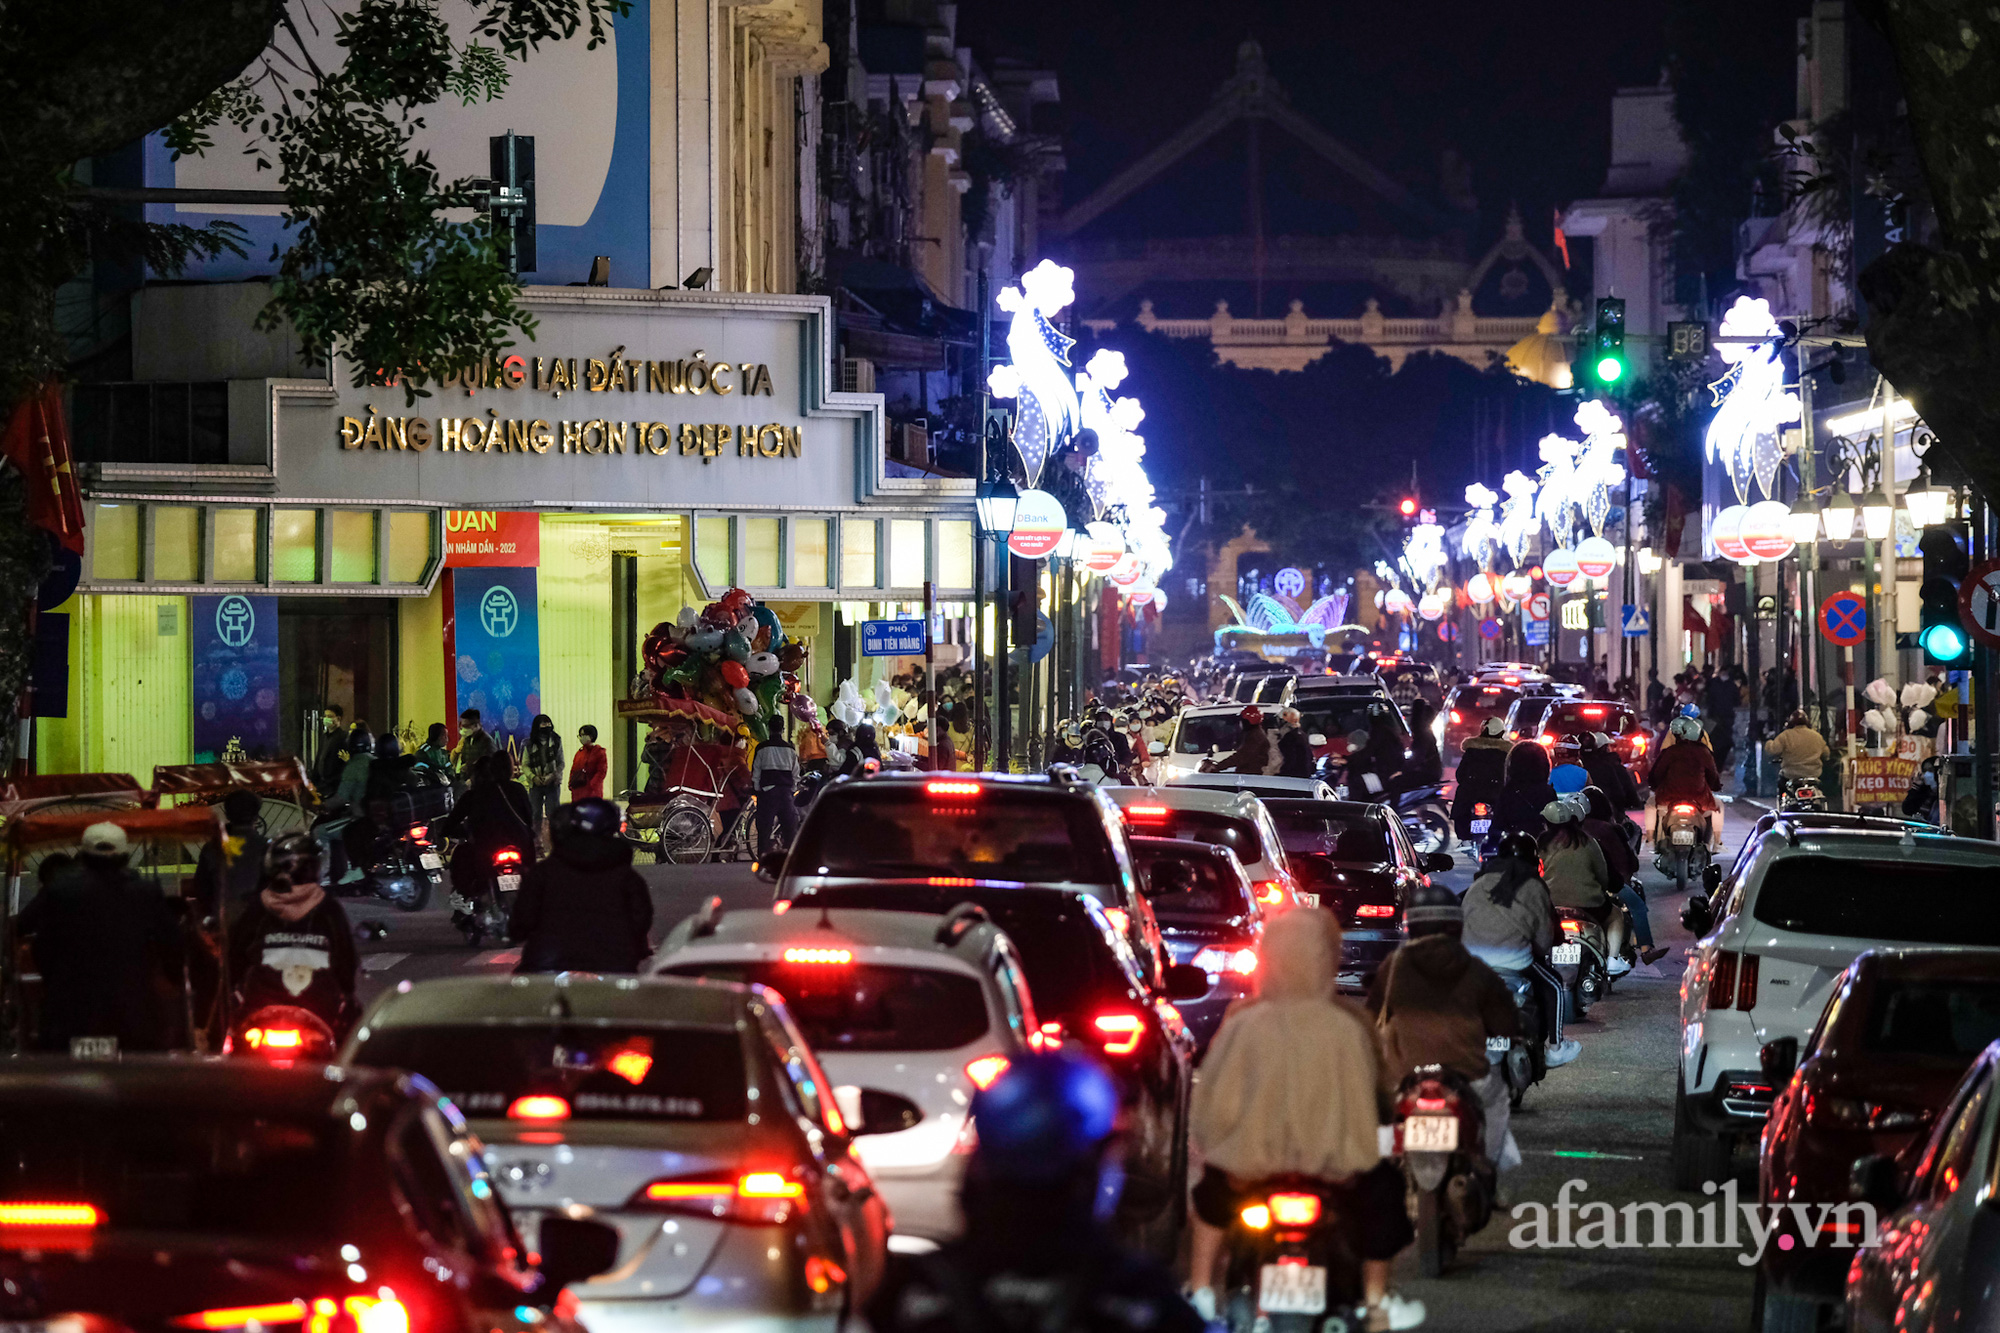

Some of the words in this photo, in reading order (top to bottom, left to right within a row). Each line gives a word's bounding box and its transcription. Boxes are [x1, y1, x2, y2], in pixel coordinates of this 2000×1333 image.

[535, 356, 577, 398] LẠI
[587, 345, 642, 392] ĐẤT
[647, 349, 733, 396] NƯỚC
[740, 362, 774, 397] TA
[341, 403, 433, 452] ĐÀNG
[440, 408, 554, 454] HOÀNG
[560, 418, 628, 455] HƠN
[633, 421, 672, 456] TO
[678, 422, 732, 465] ĐẸP
[738, 422, 802, 459] HƠN
[456, 540, 477, 553] NHÂM
[500, 542, 516, 553] 2022
[888, 623, 908, 632] PHỐ
[867, 638, 882, 650] ĐINH
[899, 635, 920, 650] HOÀNG
[1858, 758, 1882, 775] XÚC
[1886, 758, 1914, 776] XÍCH
[1857, 777, 1884, 791] KẸO
